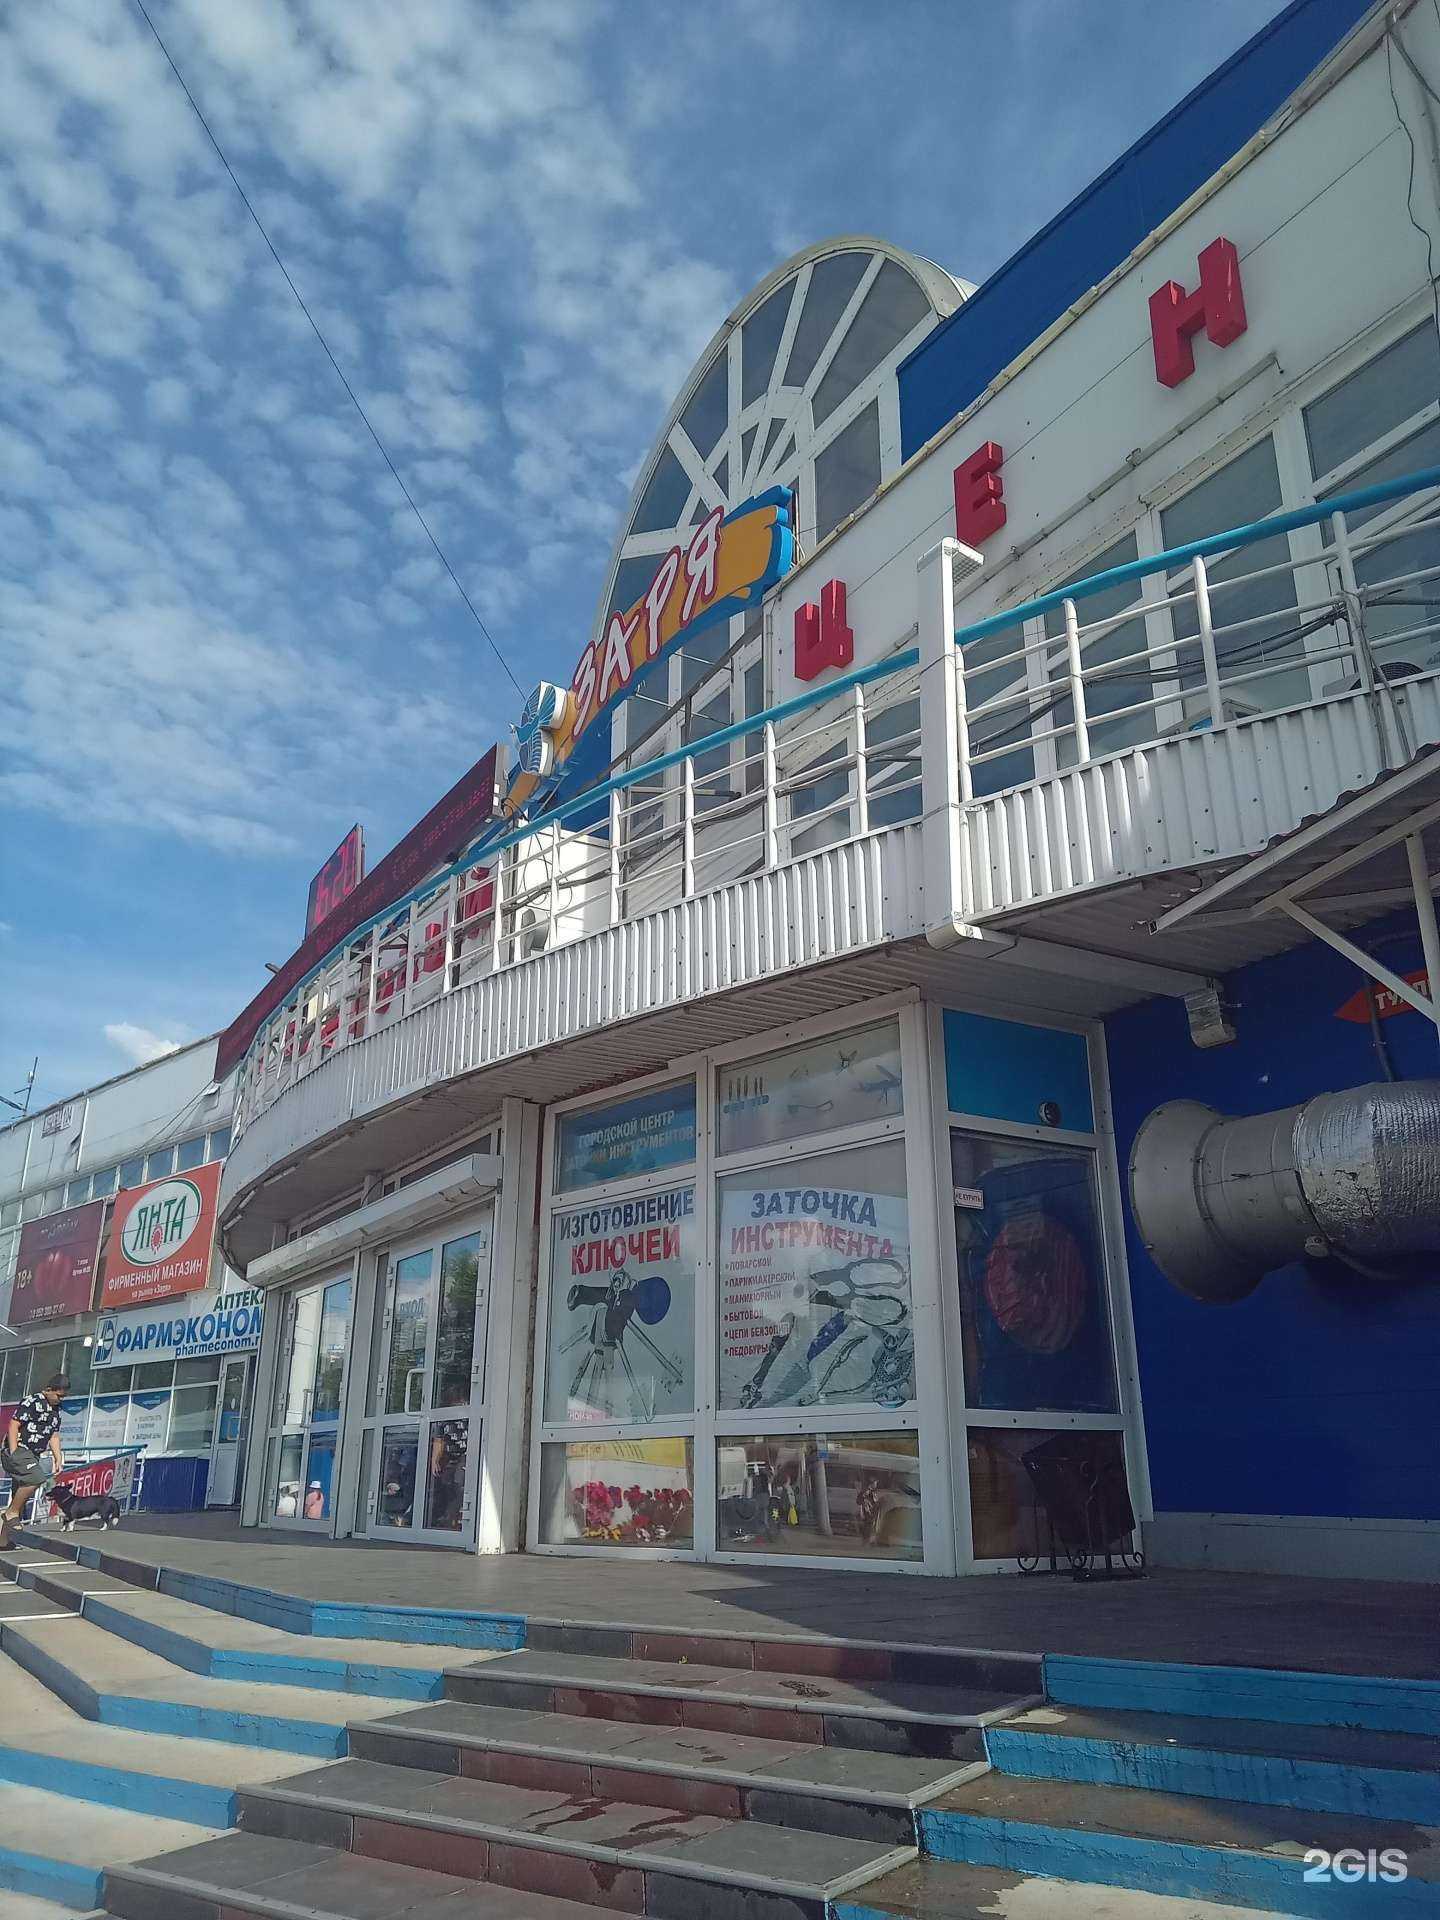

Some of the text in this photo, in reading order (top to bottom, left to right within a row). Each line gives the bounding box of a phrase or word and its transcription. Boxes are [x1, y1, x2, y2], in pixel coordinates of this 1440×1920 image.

[640, 1110, 675, 1133] ЦЕНТР
[132, 1196, 187, 1250] ЯНТА
[560, 1189, 695, 1240] ИЗГОТОВЛЕНИЕ
[751, 1189, 877, 1227] ЗАТОЧКА
[571, 1218, 681, 1275] КЛЮЧЕЙ
[731, 1221, 893, 1259] ИНСТРУМЕНТА
[16, 1270, 32, 1289] 18+
[108, 1264, 160, 1291] ФИРМЕННЫЙ
[161, 1258, 203, 1280] МАГАЗИН
[728, 1329, 749, 1341] ЦЕПИ
